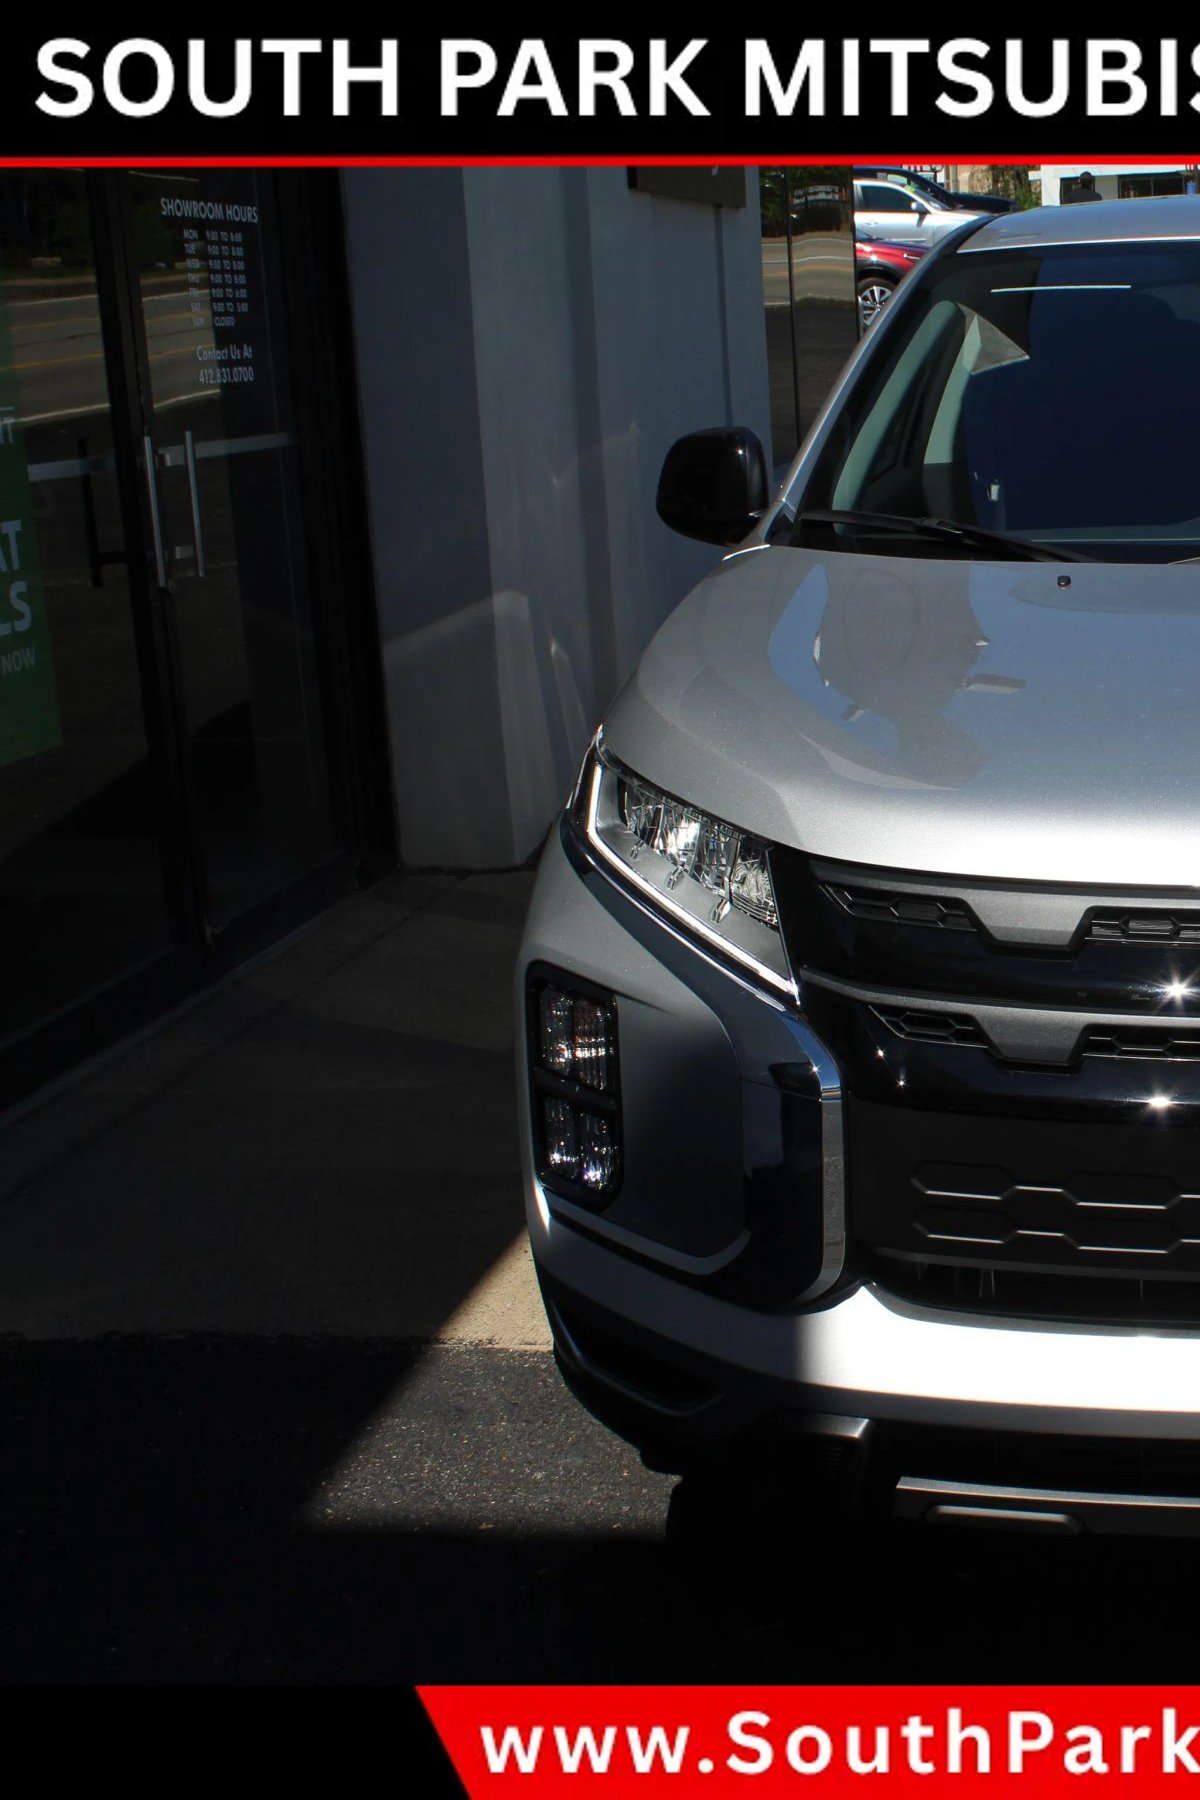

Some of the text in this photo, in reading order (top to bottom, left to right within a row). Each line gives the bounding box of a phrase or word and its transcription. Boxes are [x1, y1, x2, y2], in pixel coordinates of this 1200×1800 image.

[160, 197, 258, 224] SHOWROOM HOURS
[220, 231, 228, 242] TO
[221, 245, 230, 256] TO
[222, 260, 231, 270] TO
[224, 274, 232, 284] TO
[225, 288, 233, 298] TO
[226, 302, 234, 312] TO
[196, 343, 252, 361] Contact Us At
[199, 366, 255, 384] 412.831.0700
